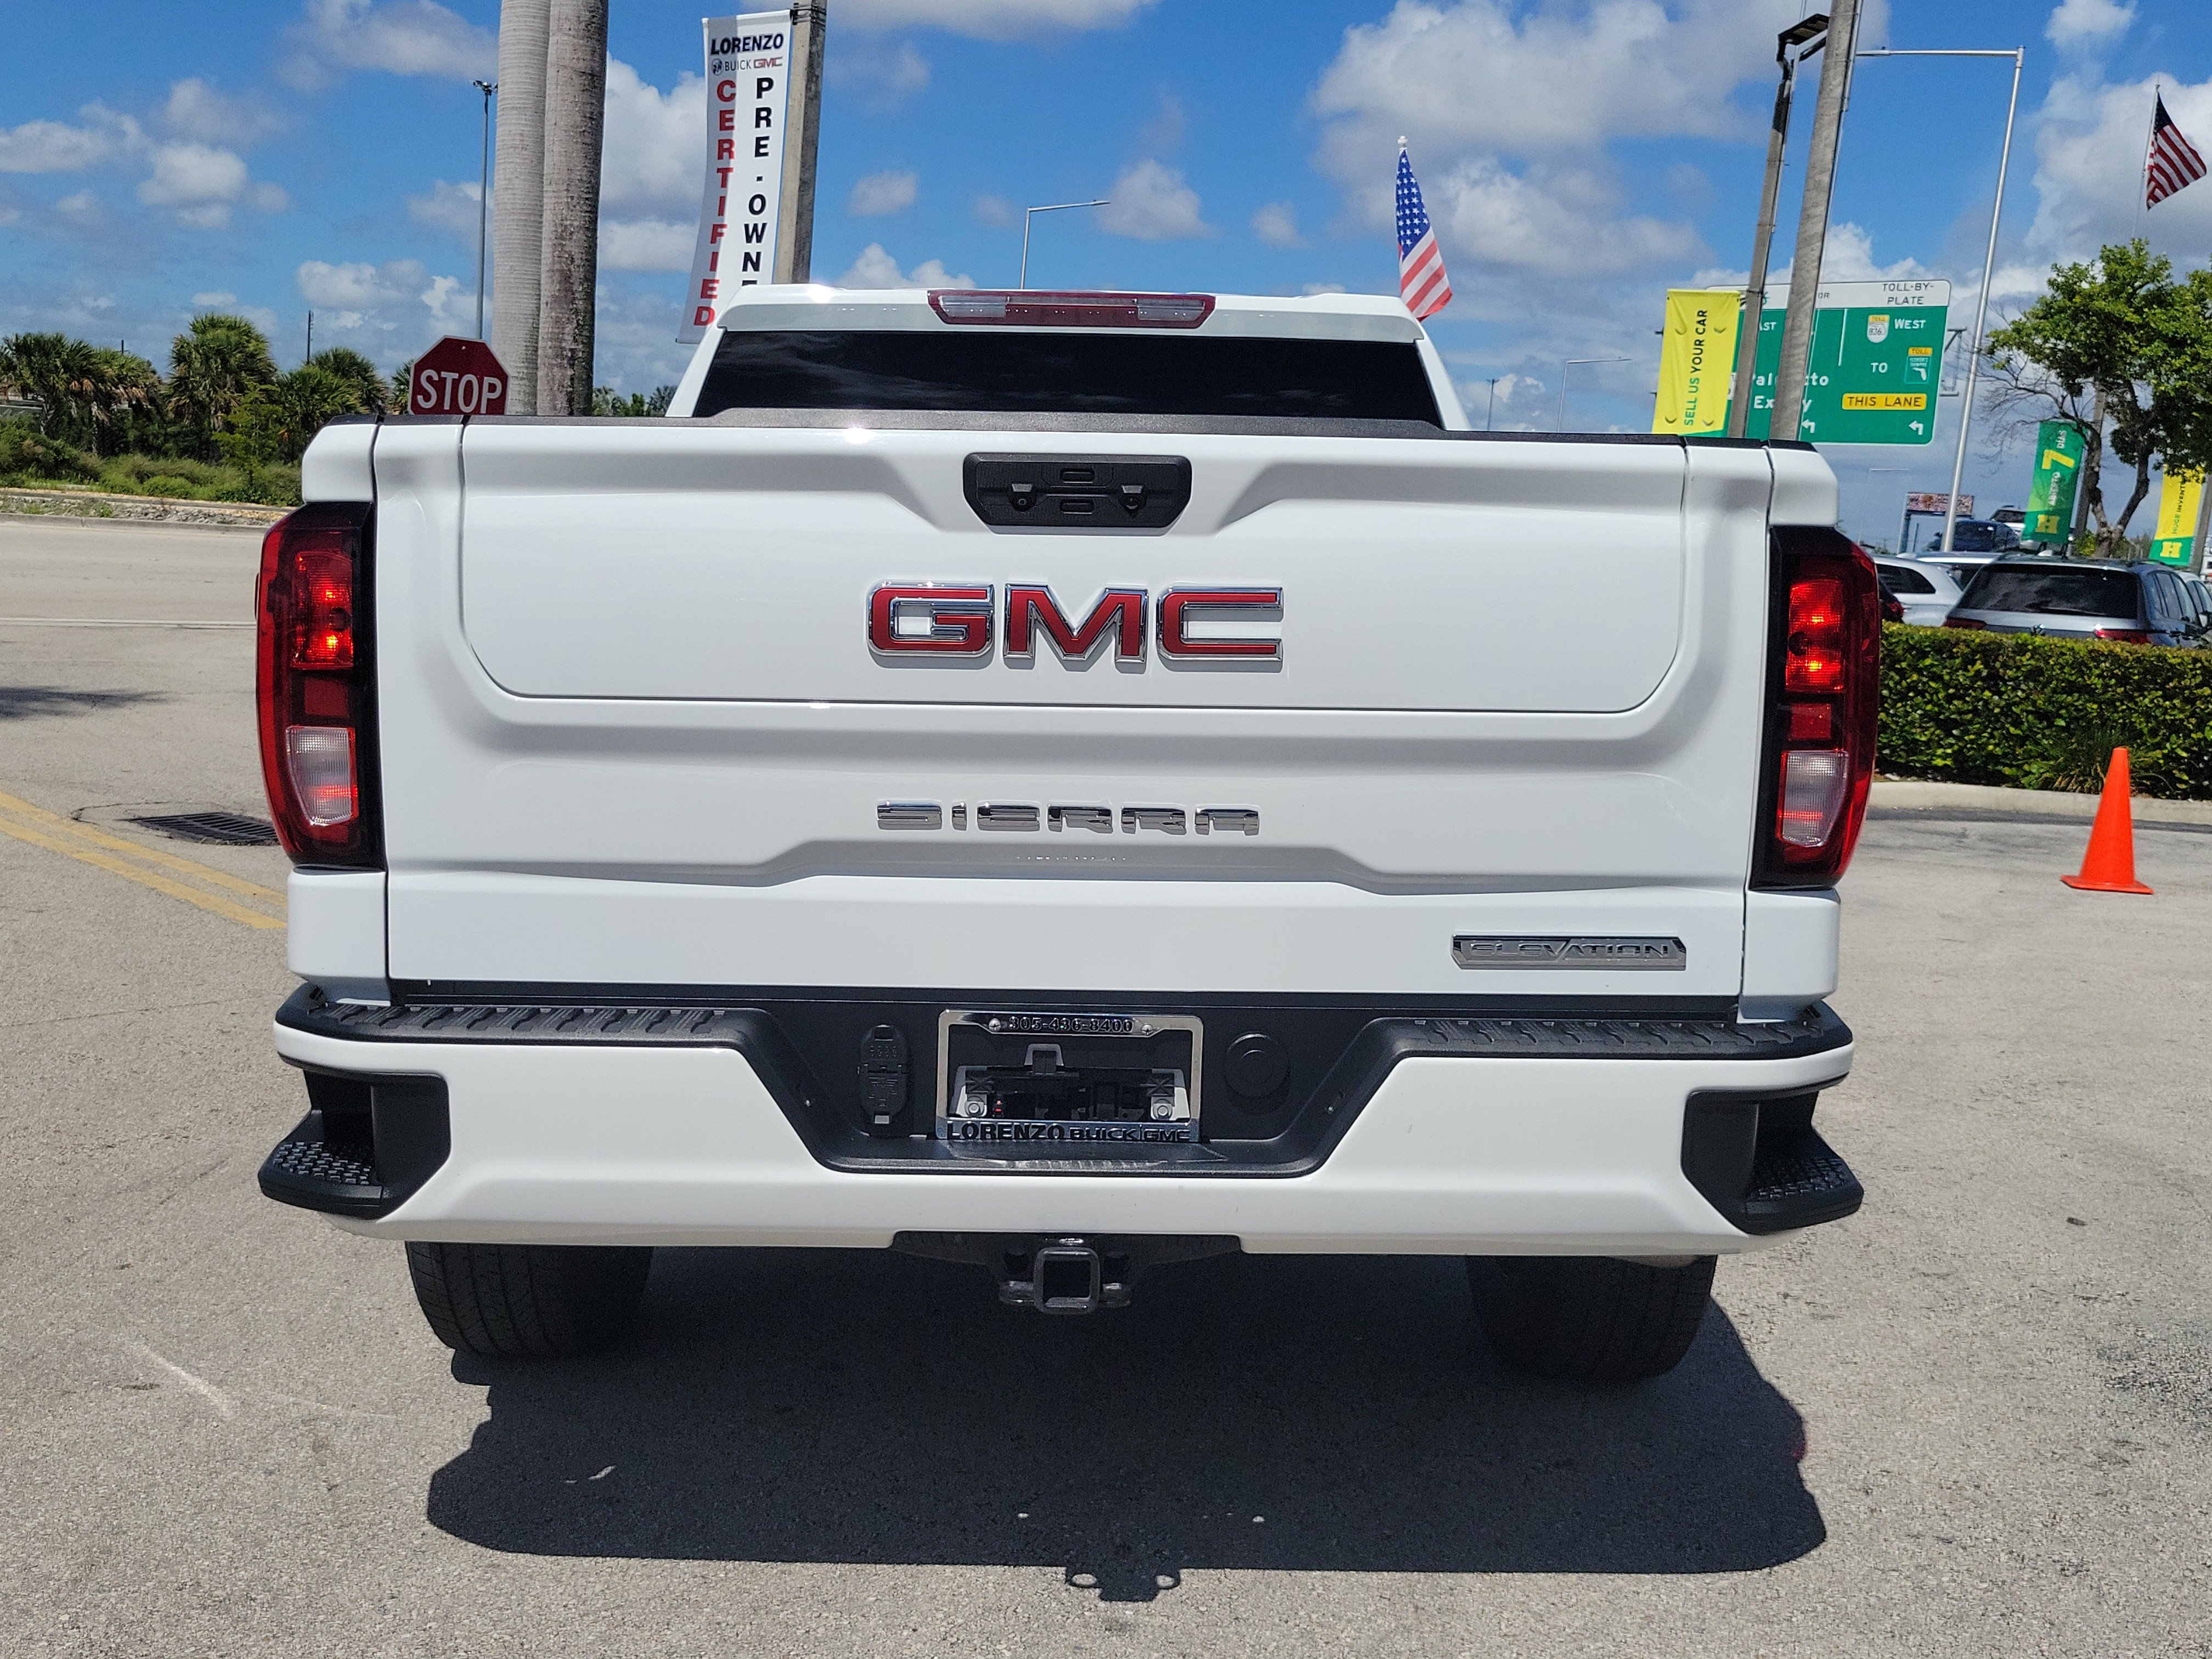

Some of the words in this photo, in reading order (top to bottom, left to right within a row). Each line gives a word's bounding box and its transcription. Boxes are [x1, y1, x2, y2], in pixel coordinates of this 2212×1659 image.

[710, 33, 784, 55] LORENZO
[725, 59, 751, 71] BUICK
[754, 56, 783, 69] GMC
[741, 77, 774, 286] PRE-OWN
[694, 80, 737, 326] CERTIFIED
[1883, 283, 1934, 292] TOLL-BY-
[1887, 296, 1924, 305] PLATE
[1696, 310, 1707, 335] CAR
[1894, 318, 1926, 329] WEST
[1690, 339, 1705, 374] YOUR
[1871, 363, 1888, 373] TO
[417, 369, 502, 414] STOP
[1688, 377, 1700, 393] US
[1684, 397, 1697, 426] SELL
[1848, 397, 1876, 407] THIS
[1884, 397, 1922, 407] LANE
[2041, 449, 2075, 470] 7
[868, 579, 1284, 664] GMC
[877, 800, 1260, 836] SIERRA
[1470, 940, 1668, 958] ELEVATION
[1009, 1015, 1133, 1032] 305-436-8400
[947, 1120, 1065, 1140] LORENZO
[1069, 1127, 1138, 1141] BUICK
[1143, 1128, 1190, 1142] GMC
